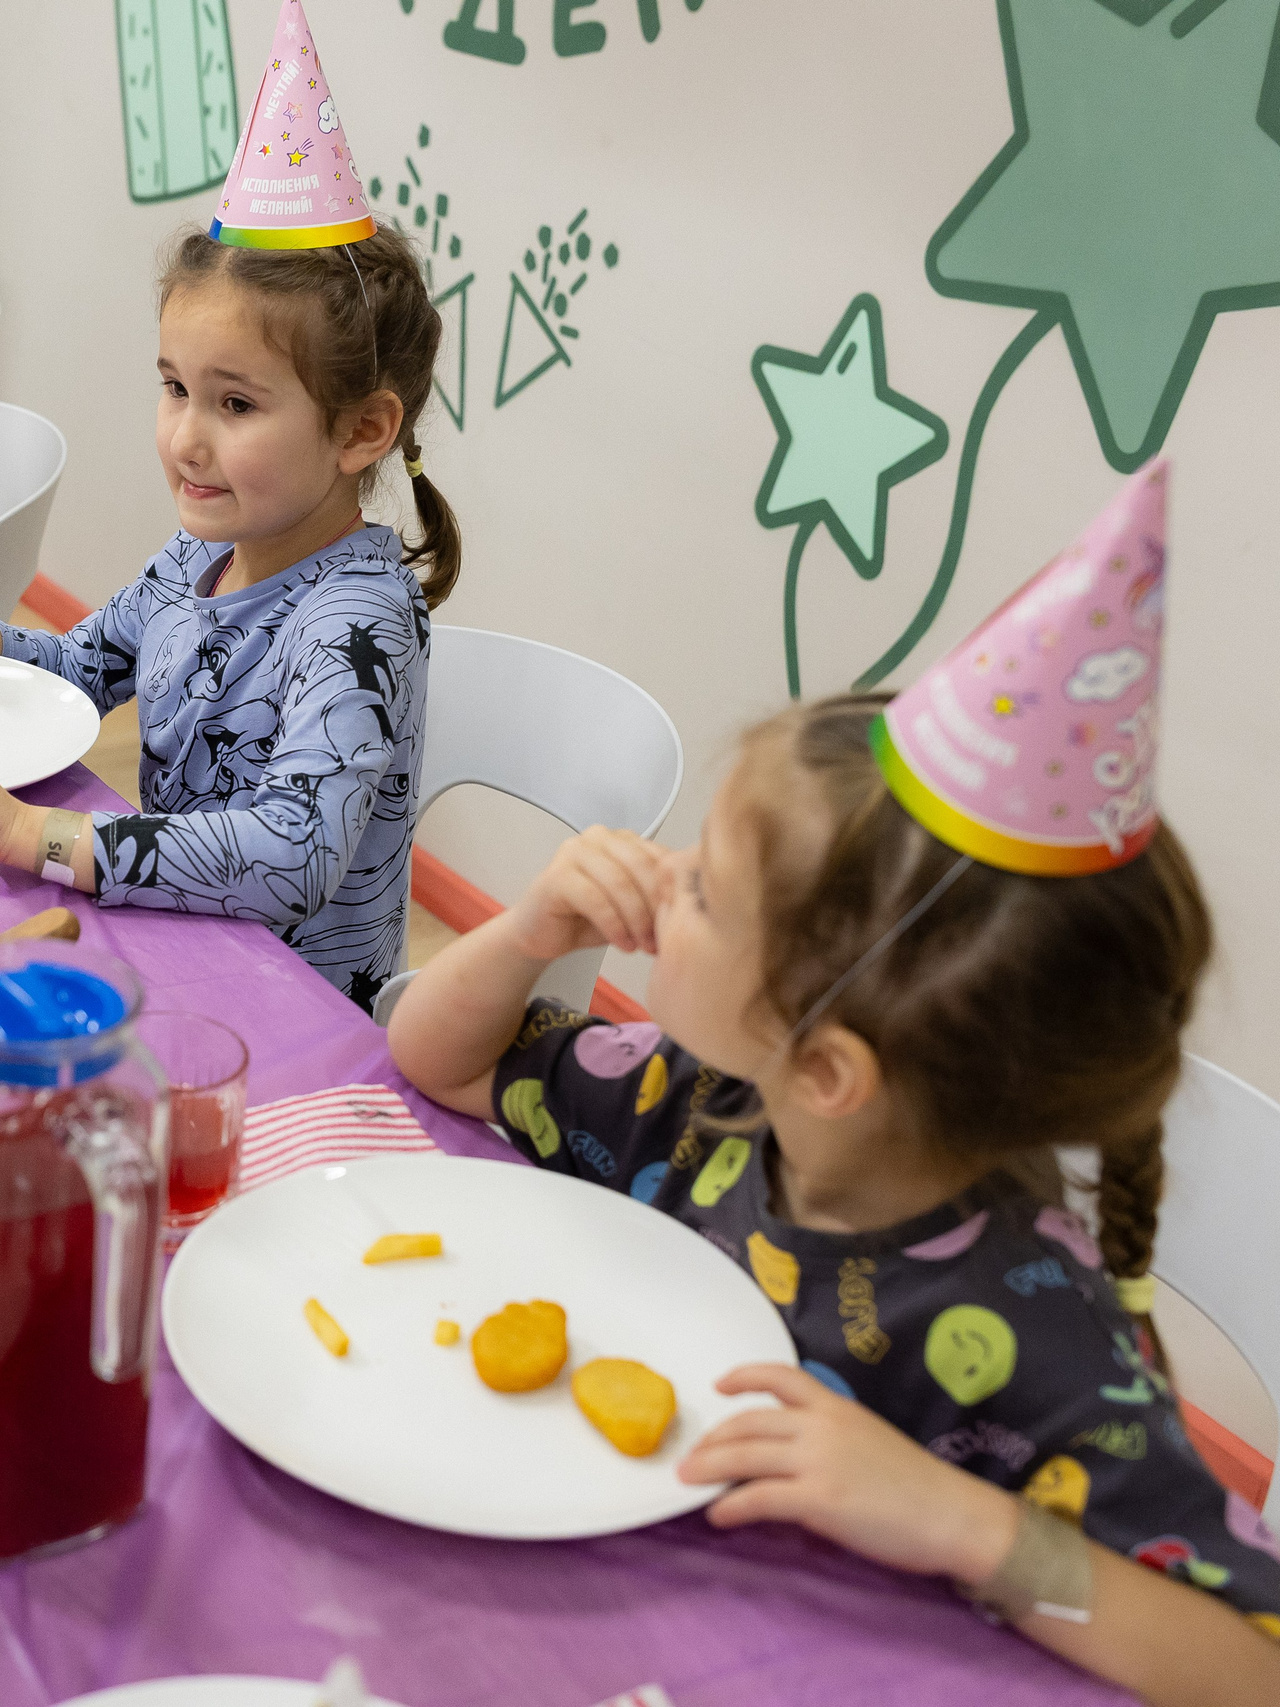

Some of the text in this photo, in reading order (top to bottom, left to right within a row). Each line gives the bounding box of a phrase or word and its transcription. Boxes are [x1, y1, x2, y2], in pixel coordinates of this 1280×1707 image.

[264, 59, 303, 120] МЕЧТАЙ!
[241, 174, 320, 194] ИСПОЛНЕНИЯ
[249, 195, 313, 215] ЖЕЛАНИЙ!
